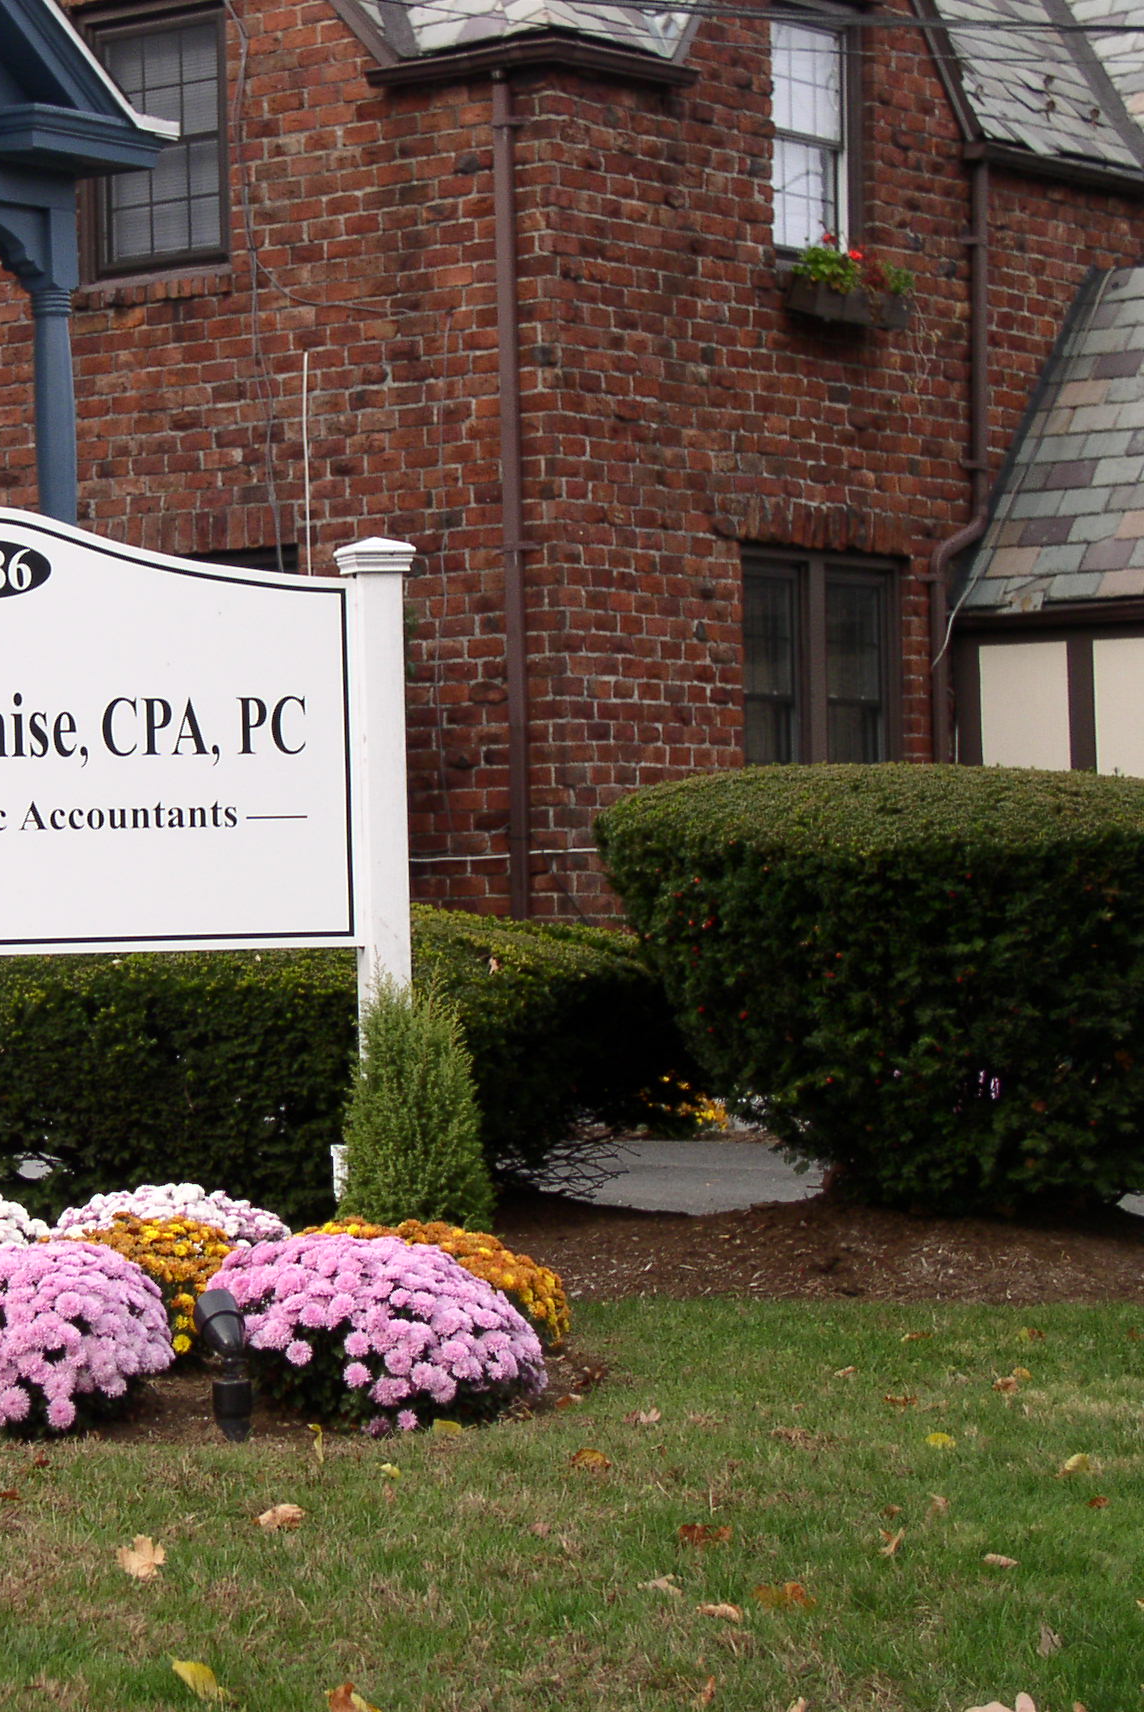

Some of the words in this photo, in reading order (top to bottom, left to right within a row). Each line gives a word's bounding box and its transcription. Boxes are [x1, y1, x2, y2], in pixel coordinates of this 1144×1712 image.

[101, 696, 220, 766] CPA,
[236, 695, 306, 755] PC
[20, 800, 238, 831] Accountants
